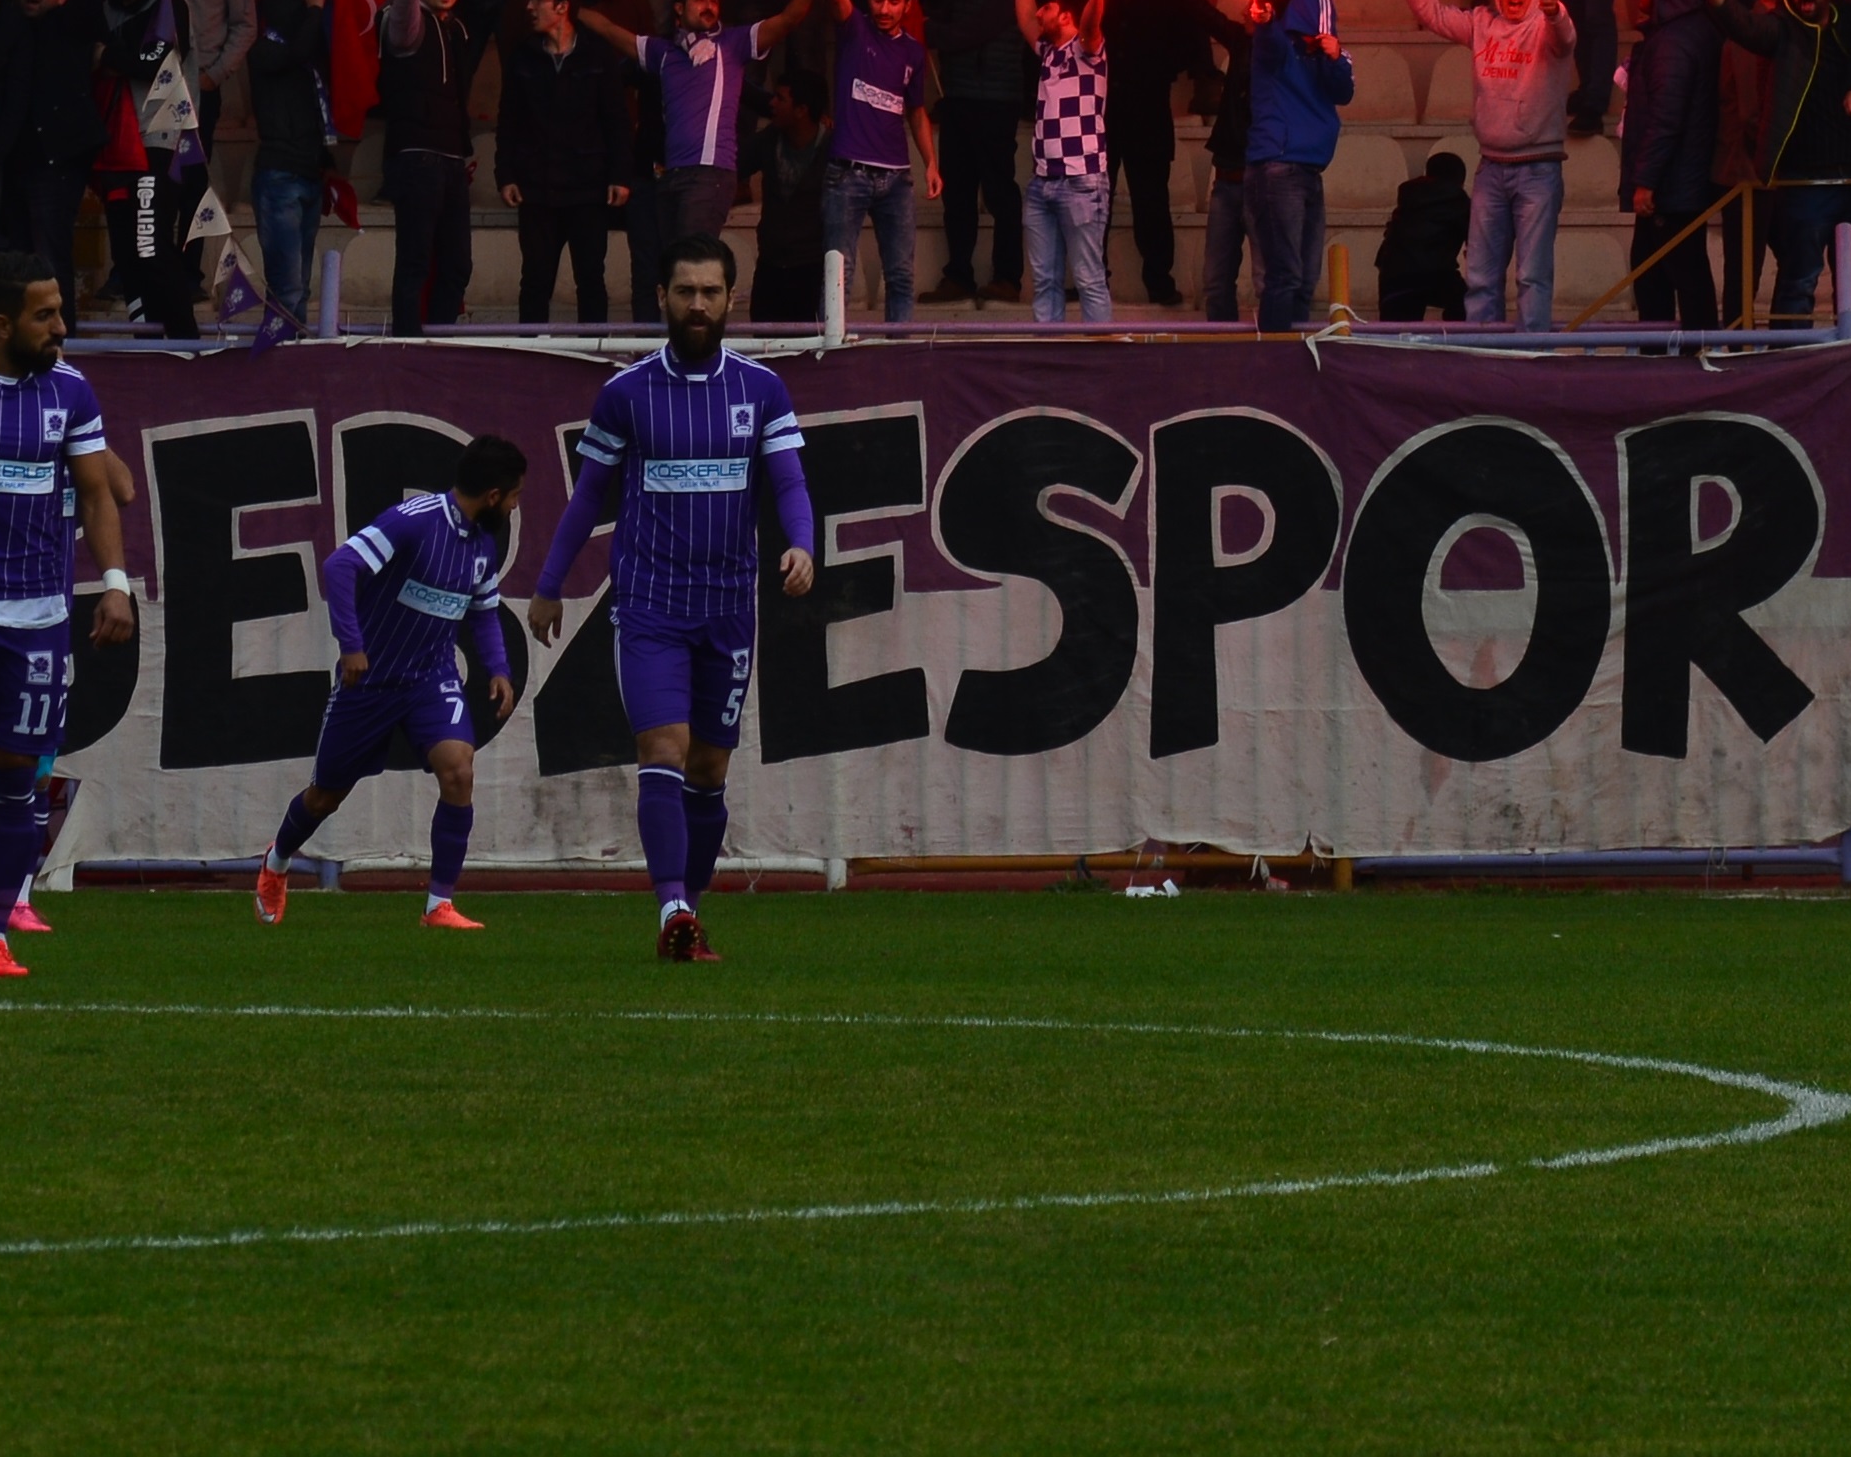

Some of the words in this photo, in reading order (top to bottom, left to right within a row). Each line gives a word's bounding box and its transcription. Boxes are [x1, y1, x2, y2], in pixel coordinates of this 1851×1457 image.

[12, 691, 51, 735] 11
[443, 696, 464, 725] 7
[720, 687, 744, 727] 5
